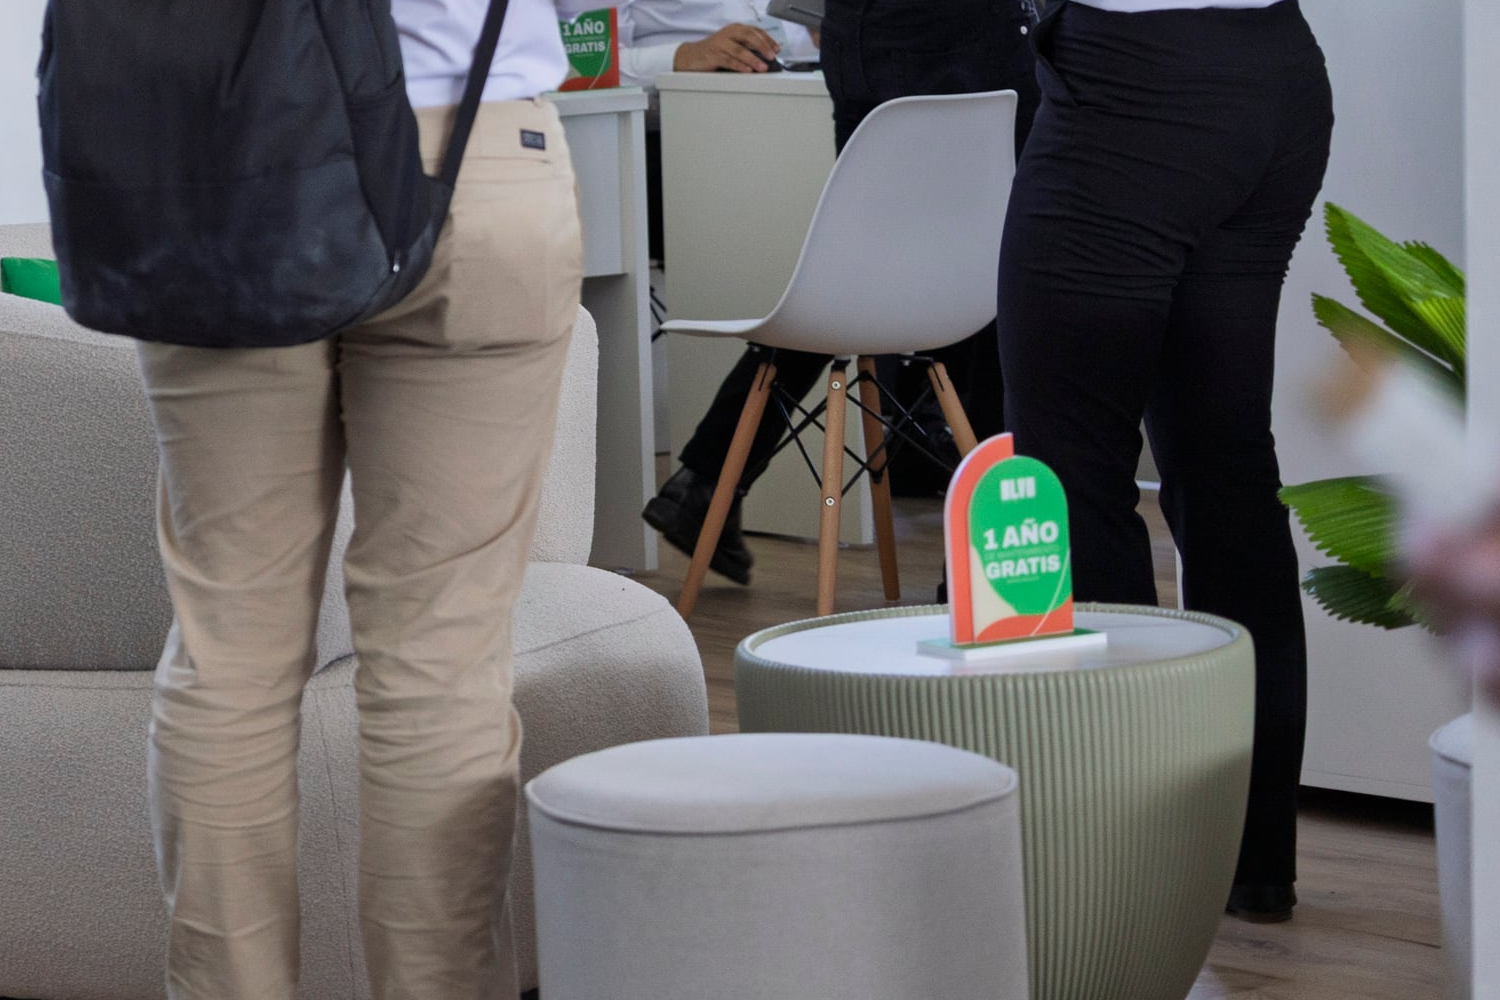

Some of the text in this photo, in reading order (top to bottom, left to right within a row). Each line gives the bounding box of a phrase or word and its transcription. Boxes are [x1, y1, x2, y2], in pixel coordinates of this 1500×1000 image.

[563, 18, 605, 37] 1 AÑO
[564, 41, 606, 55] GRATIS
[984, 517, 1059, 551] 1 AÑO
[986, 554, 1060, 580] GRATIS
